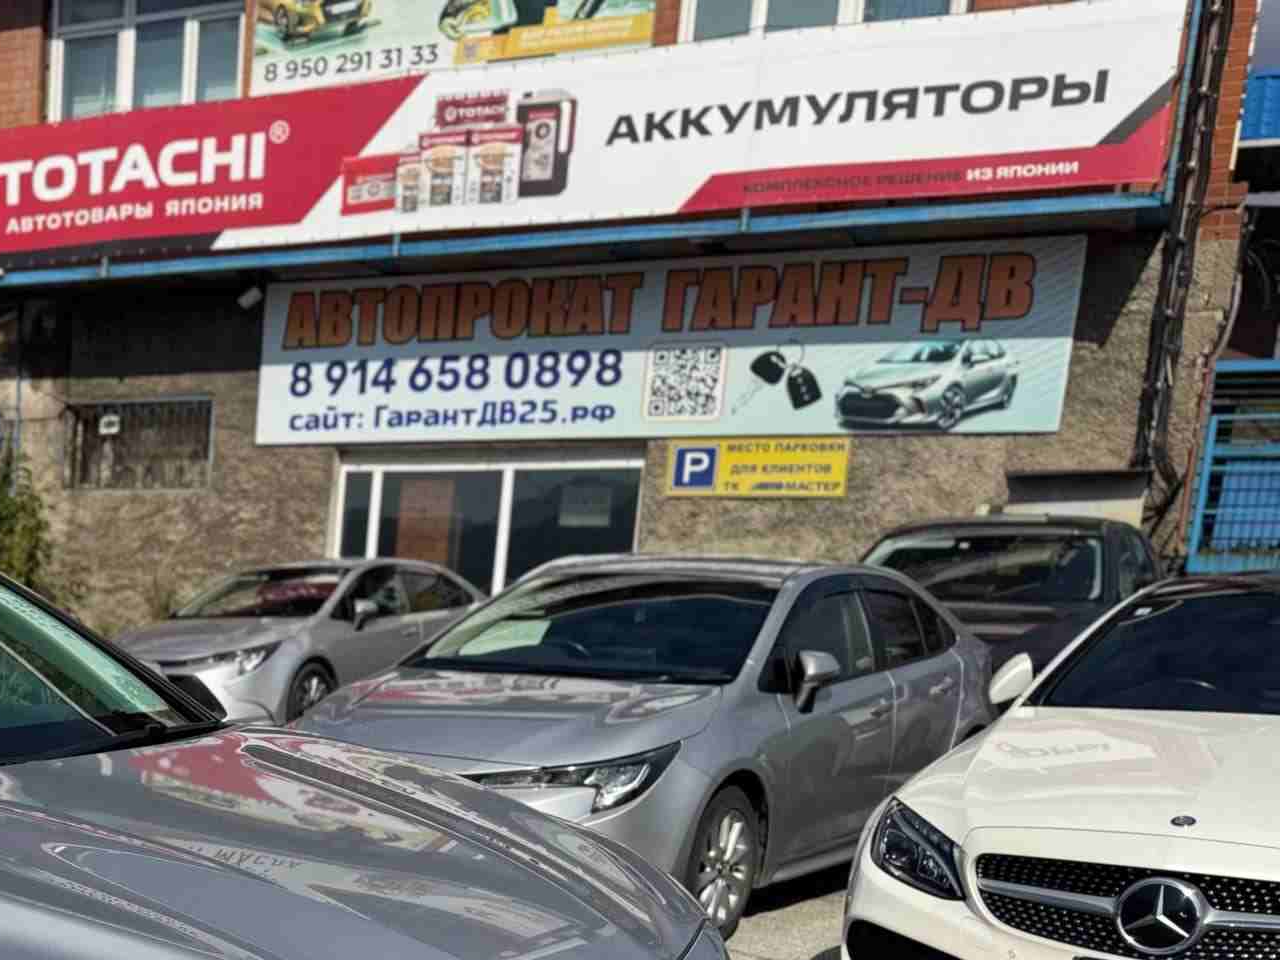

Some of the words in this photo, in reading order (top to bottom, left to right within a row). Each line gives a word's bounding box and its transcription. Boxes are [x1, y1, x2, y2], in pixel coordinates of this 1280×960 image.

[263, 62, 278, 83] 8
[285, 55, 328, 80] 950
[336, 50, 373, 74] 291
[379, 47, 403, 69] 31
[409, 43, 439, 65] 33
[605, 69, 1109, 146] АККУМУЛЯТОРЫ
[966, 167, 993, 182] ИЗ
[996, 161, 1080, 178] ЯПОНИИ
[5, 200, 154, 235] АВТОТОВАРЫ
[165, 192, 264, 218] ЯПОНИЯ
[281, 270, 645, 351] АВТОПРОКАТ
[661, 252, 1037, 333] ГАРАНТ-ДВ
[289, 361, 312, 398] 8
[324, 356, 398, 396] 914
[408, 353, 491, 393] 658
[503, 348, 624, 389] 0898
[288, 406, 366, 432] сайт:
[373, 399, 617, 428] ГарантДВ25.рф
